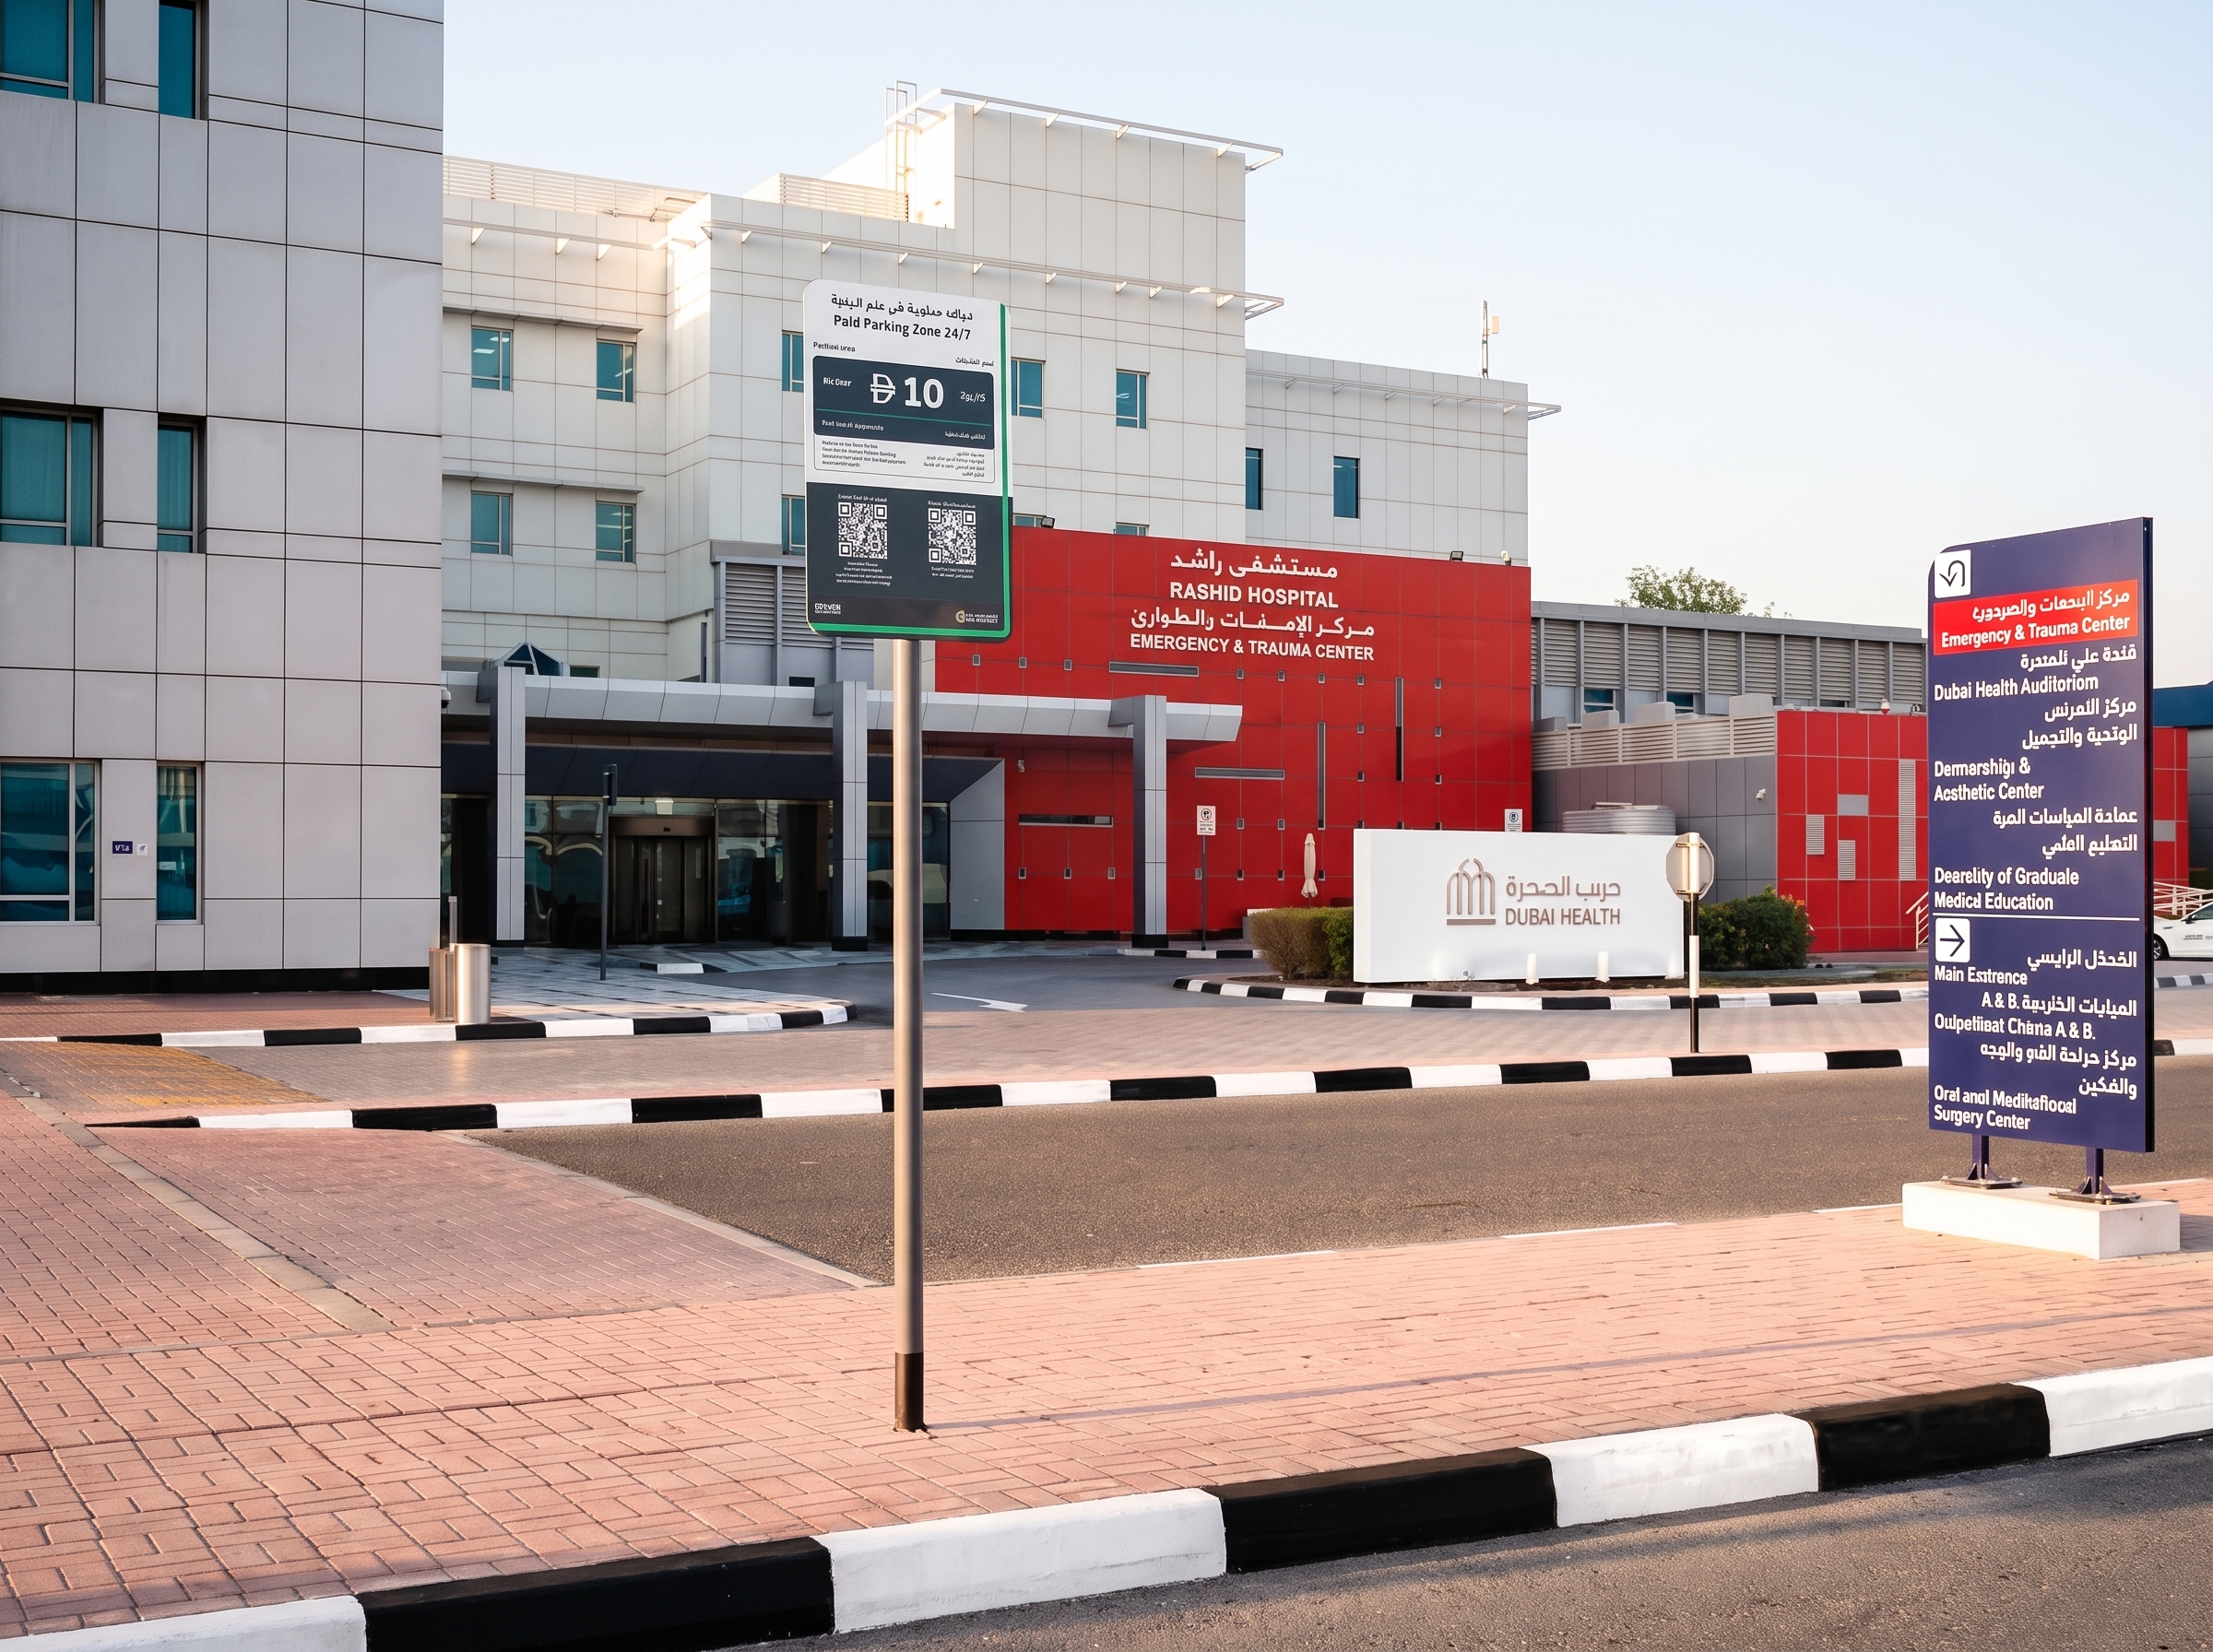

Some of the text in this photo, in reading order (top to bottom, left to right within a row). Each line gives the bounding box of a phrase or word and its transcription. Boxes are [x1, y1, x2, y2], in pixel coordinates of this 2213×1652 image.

[864, 318, 910, 337] Parking
[912, 324, 941, 337] Zone
[944, 327, 971, 341] 24/7
[904, 376, 944, 409] 10
[1170, 548, 1338, 579] مستشفى راشد
[1170, 582, 1338, 608] RASHID HOSPITAL
[1942, 615, 2131, 648] Emergency & Trauma Center
[1130, 633, 1374, 661] EMERGENCY & TRAUMA CENTER
[1935, 681, 1972, 701] Dubai
[1975, 678, 2018, 698] Health
[2018, 756, 2031, 774] &
[1998, 782, 2045, 800] Center
[1997, 867, 2013, 885] of
[1984, 891, 2053, 911] Education
[1505, 907, 1620, 926] DUBAI HEALTH
[1935, 964, 1964, 983] Main
[1994, 992, 2006, 1009] &
[2068, 1021, 2080, 1039] &
[1934, 1103, 2031, 1130] Surgery Center
